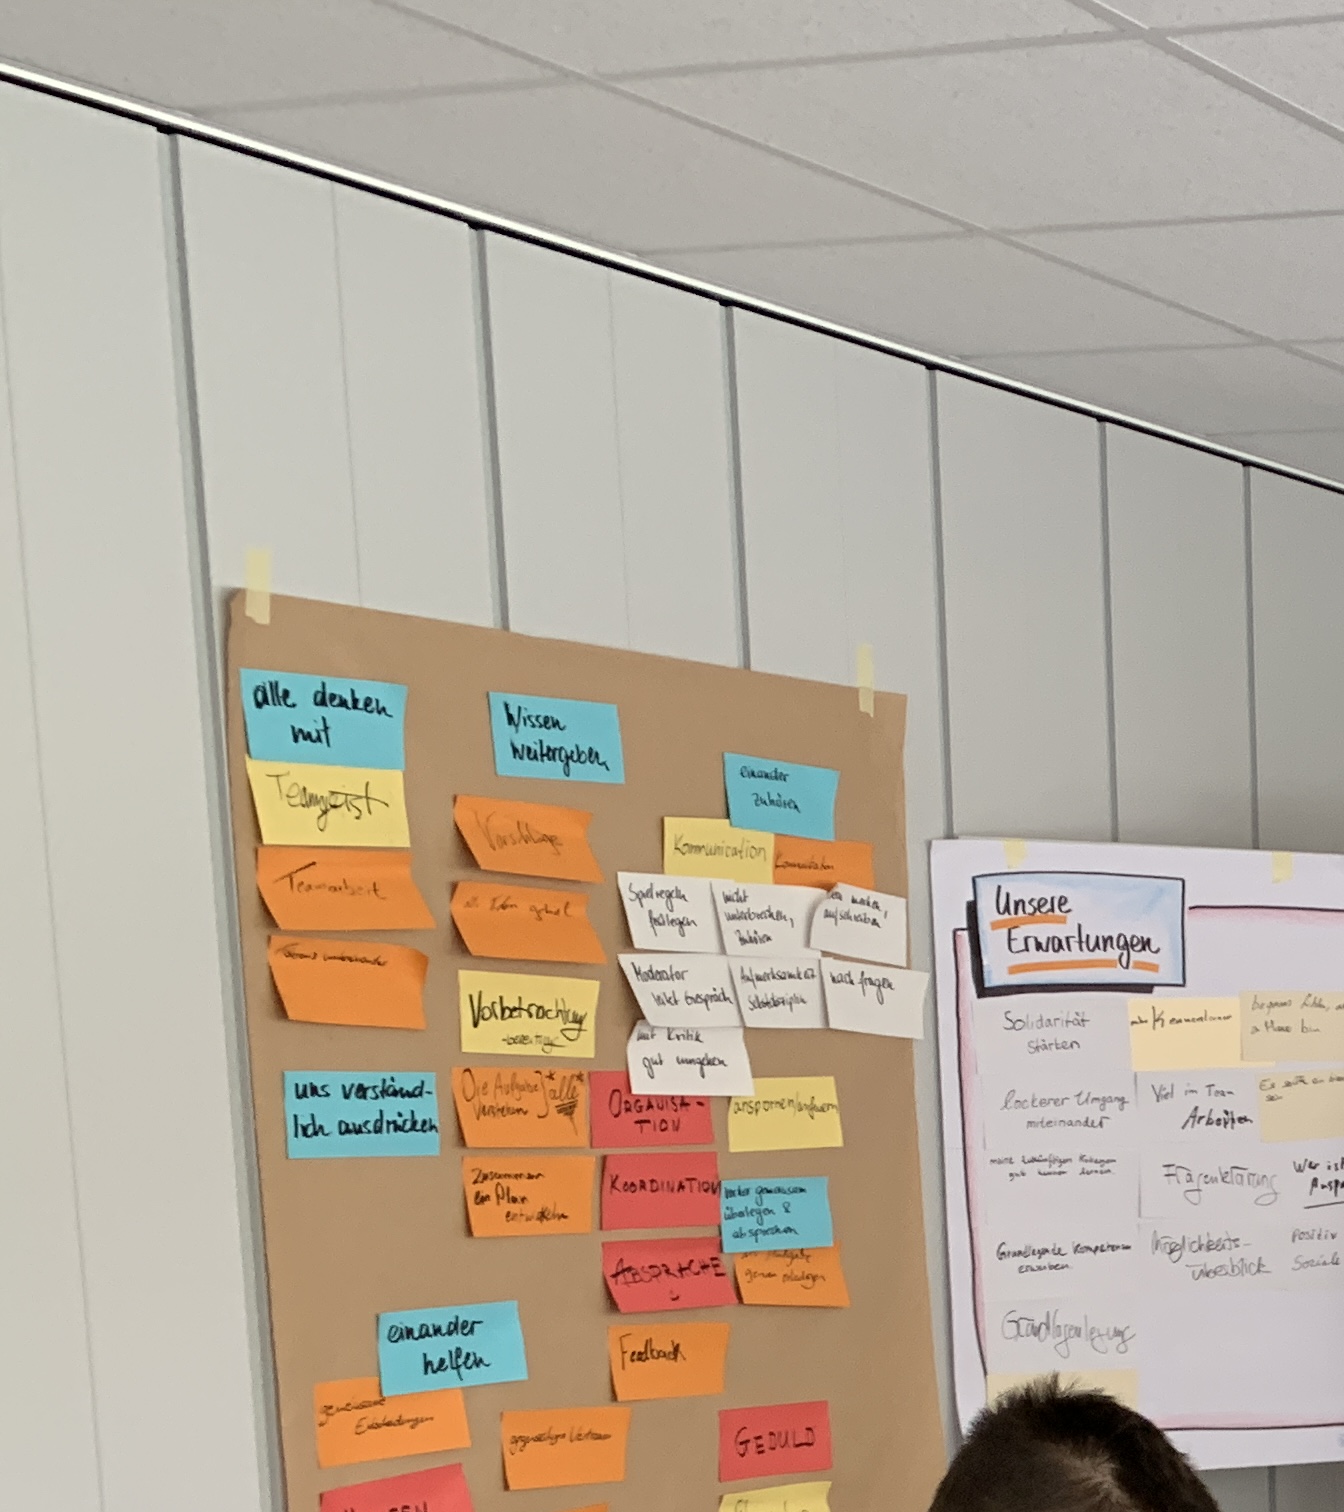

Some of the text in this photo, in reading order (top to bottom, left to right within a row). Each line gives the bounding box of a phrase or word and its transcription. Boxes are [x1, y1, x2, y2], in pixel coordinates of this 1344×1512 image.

[313, 682, 393, 718] denken
[504, 702, 566, 731] Wissen
[292, 718, 332, 748] mit
[995, 885, 1072, 916] Unsere
[1007, 925, 1159, 969] Erwartungen
[666, 1027, 703, 1043] Kritik
[1003, 1010, 1090, 1031] Solidarität
[642, 1055, 663, 1079] gut
[295, 1083, 330, 1100] uns
[293, 1110, 438, 1138] lich ausdrücken
[610, 1174, 722, 1195] KOORDINATION
[387, 1315, 483, 1343] einander
[423, 1347, 491, 1381] helfen
[619, 1333, 686, 1370] Feedback
[735, 1426, 816, 1458] GEDULD
